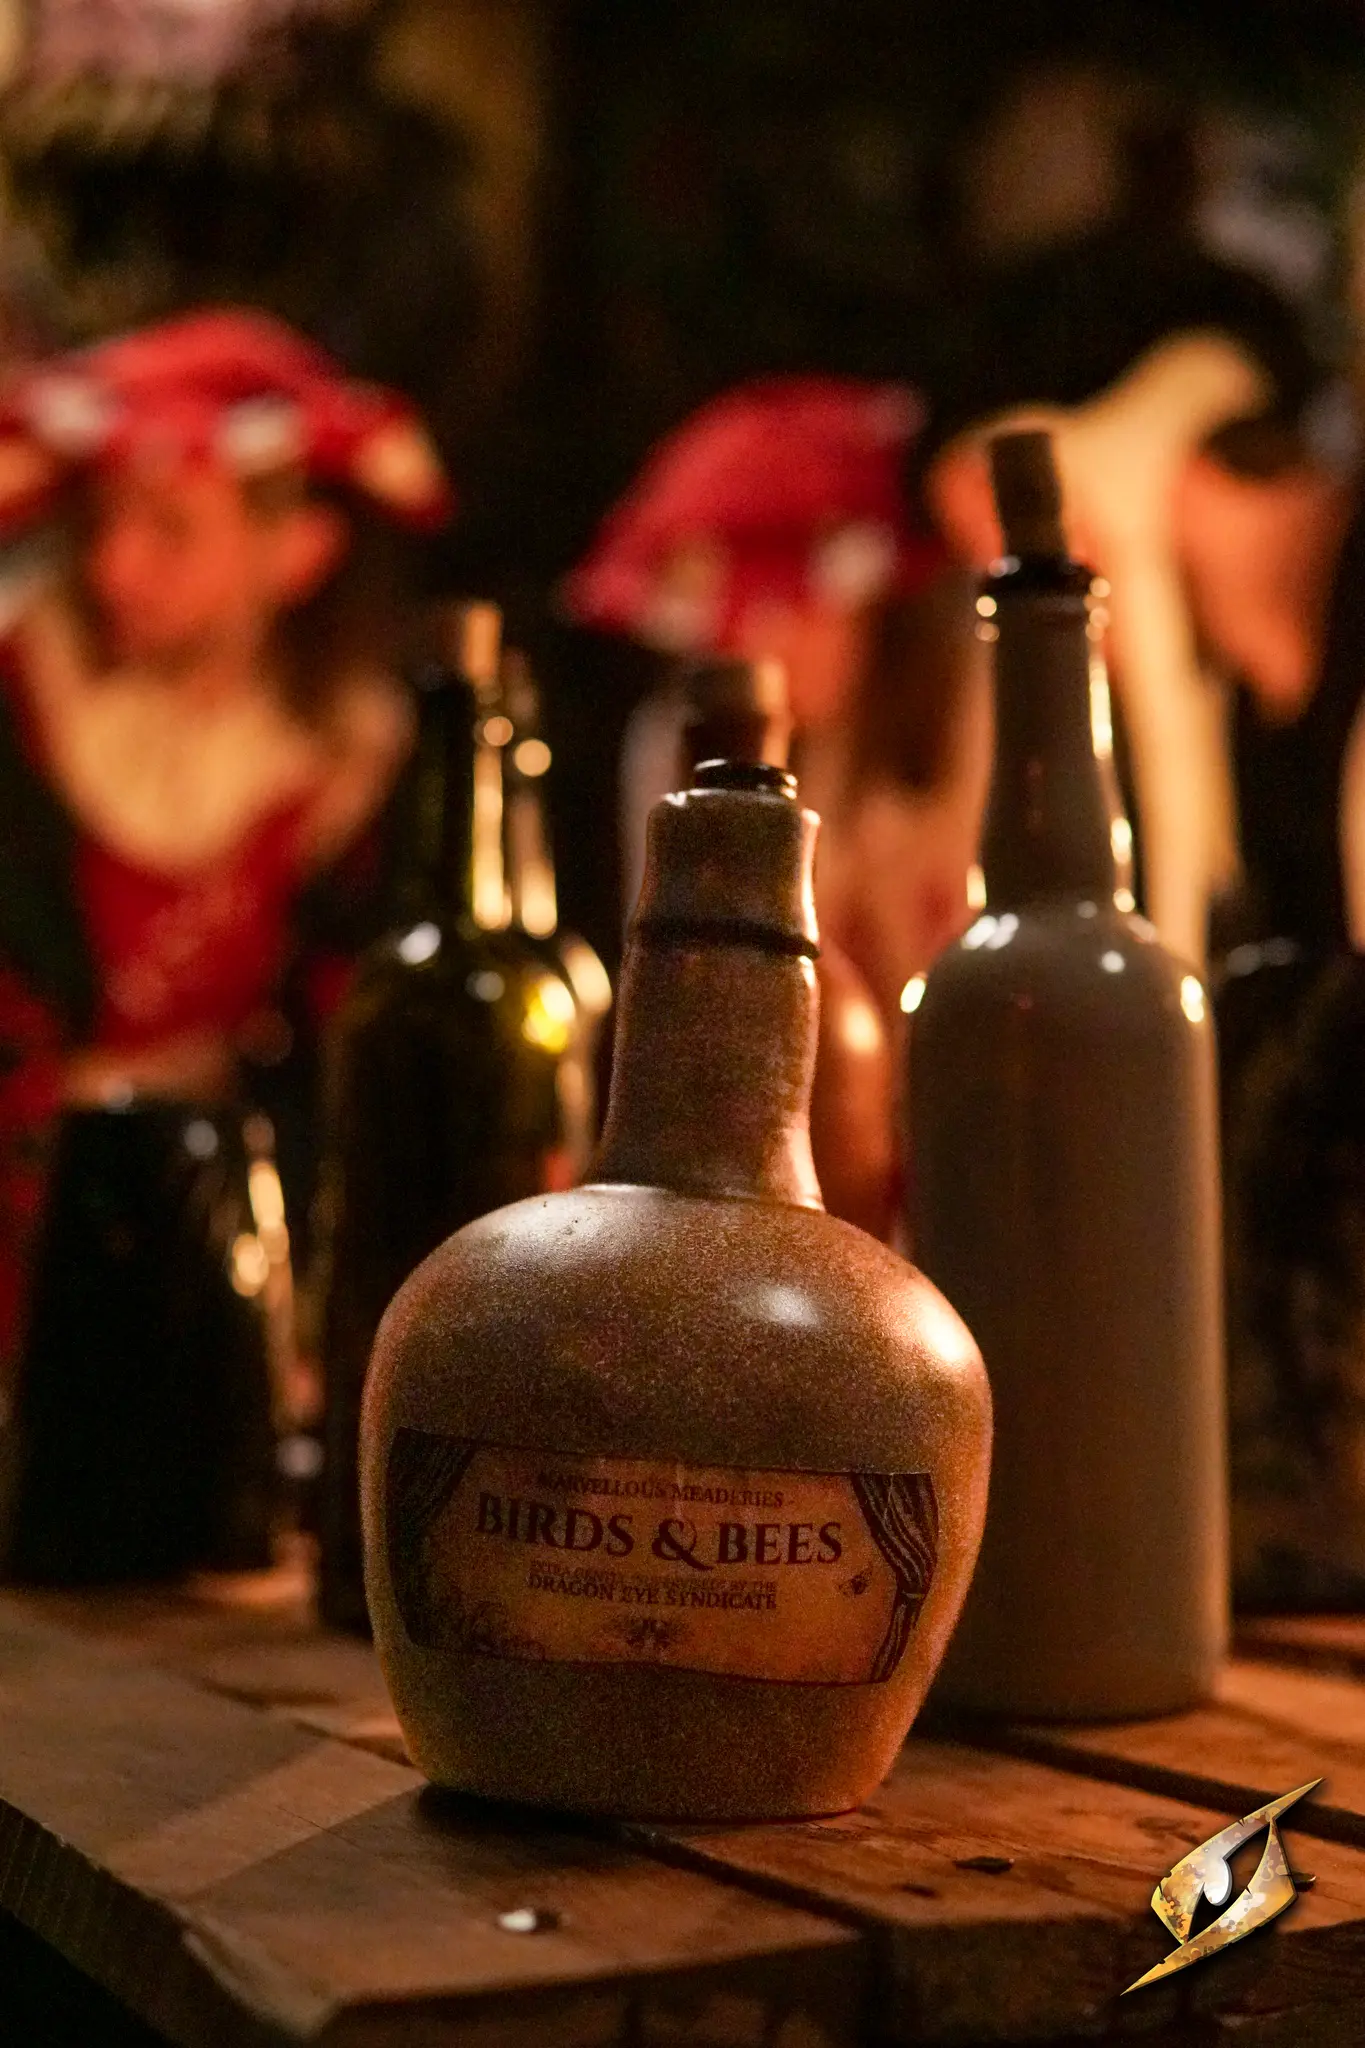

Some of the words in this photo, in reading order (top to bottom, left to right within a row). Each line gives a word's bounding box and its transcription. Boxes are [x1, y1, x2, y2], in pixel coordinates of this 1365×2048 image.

[537, 1470, 666, 1498] MARVELLOUS
[671, 1483, 784, 1508] MEADERIES
[475, 1491, 635, 1557] BIRDS
[652, 1518, 715, 1571] &
[716, 1521, 842, 1564] BEES
[528, 1573, 614, 1601] DRAGON
[665, 1588, 777, 1610] SYNDICATE
